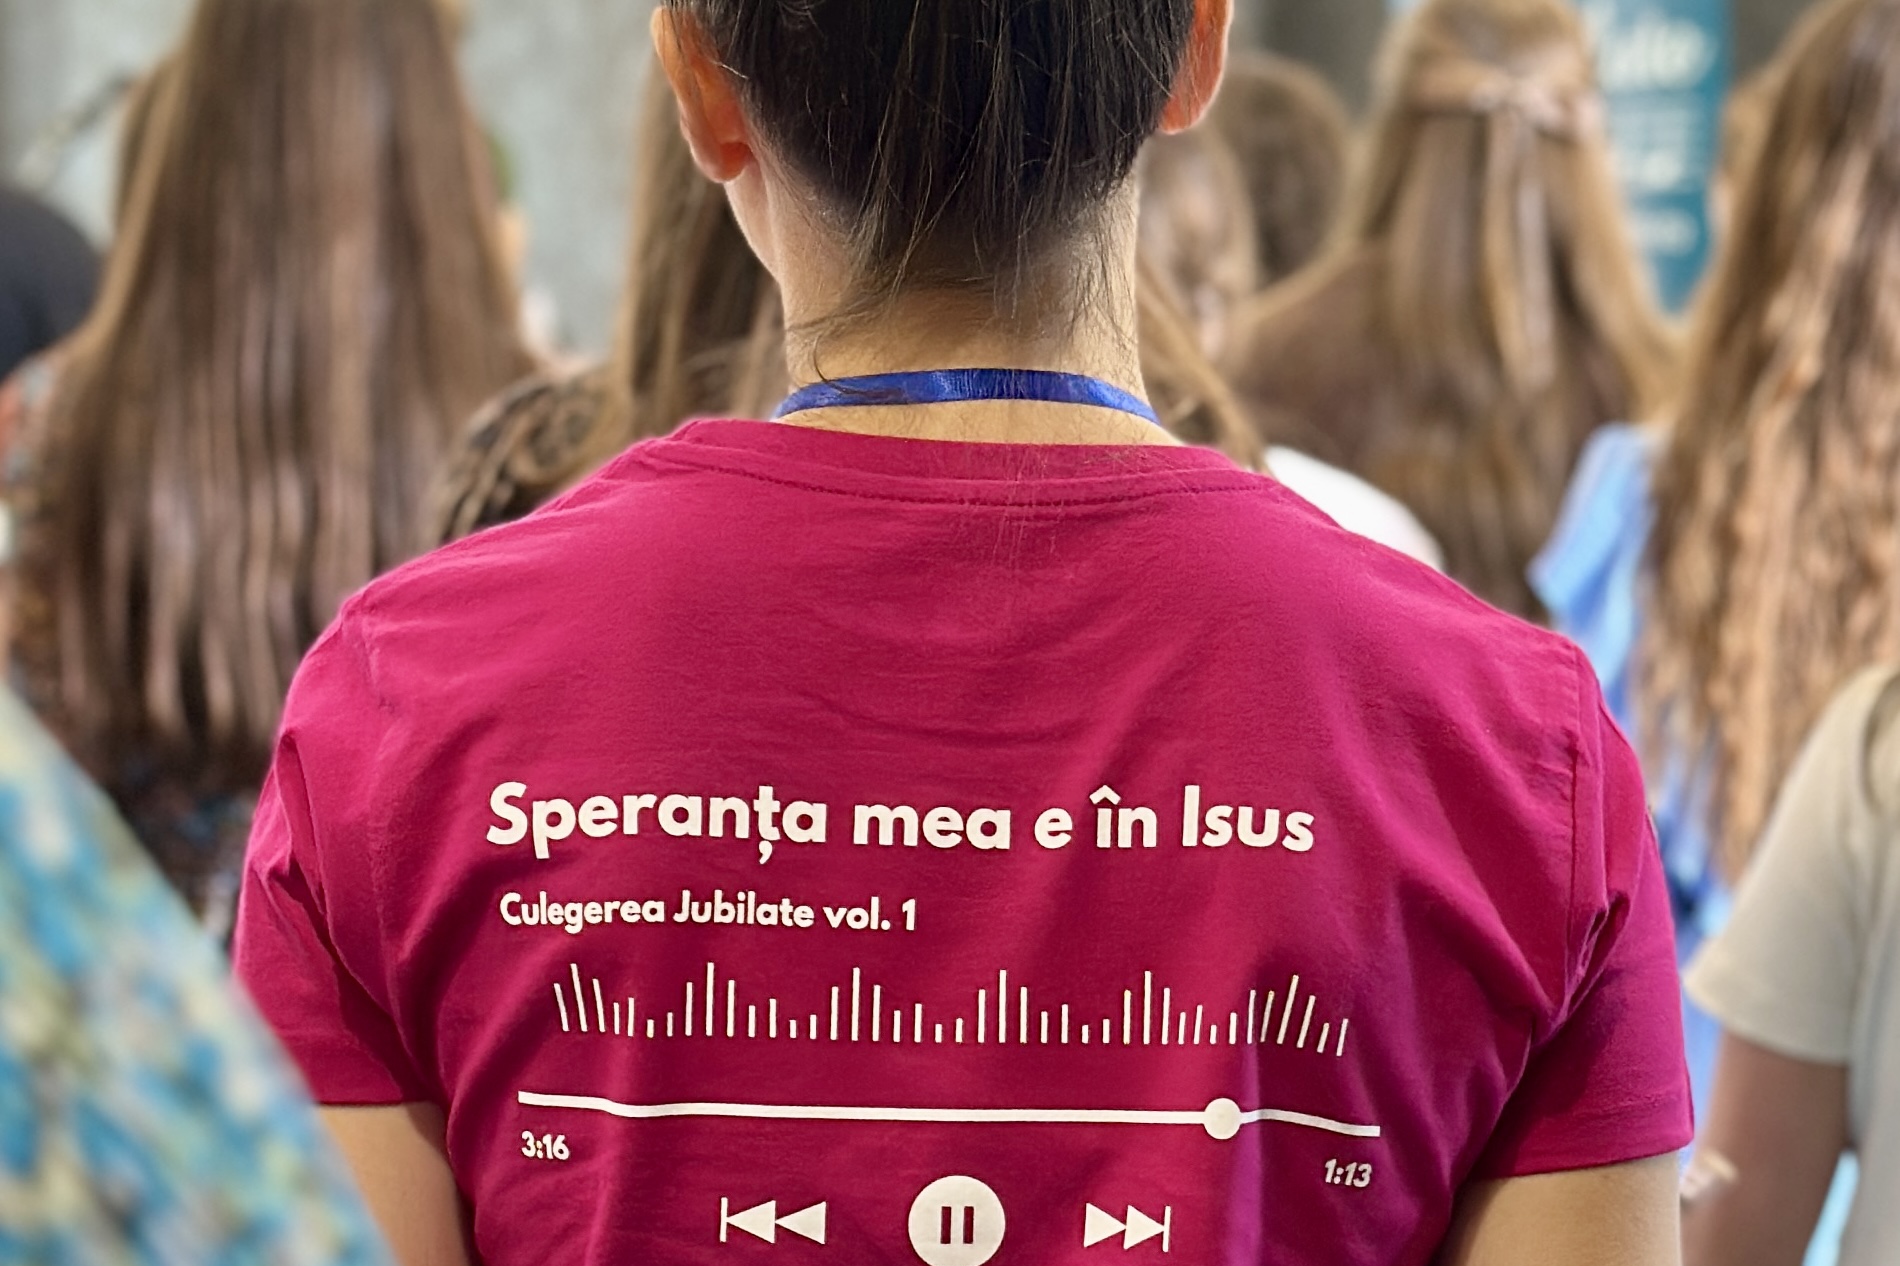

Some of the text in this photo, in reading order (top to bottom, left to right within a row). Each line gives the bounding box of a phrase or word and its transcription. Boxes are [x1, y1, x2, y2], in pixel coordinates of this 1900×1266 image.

[486, 781, 1315, 865] Speranța mea e în Isus
[499, 889, 916, 935] Culegerea Jubilate vol. 1
[521, 1130, 570, 1161] 3:16
[1324, 1158, 1373, 1188] 1:13
